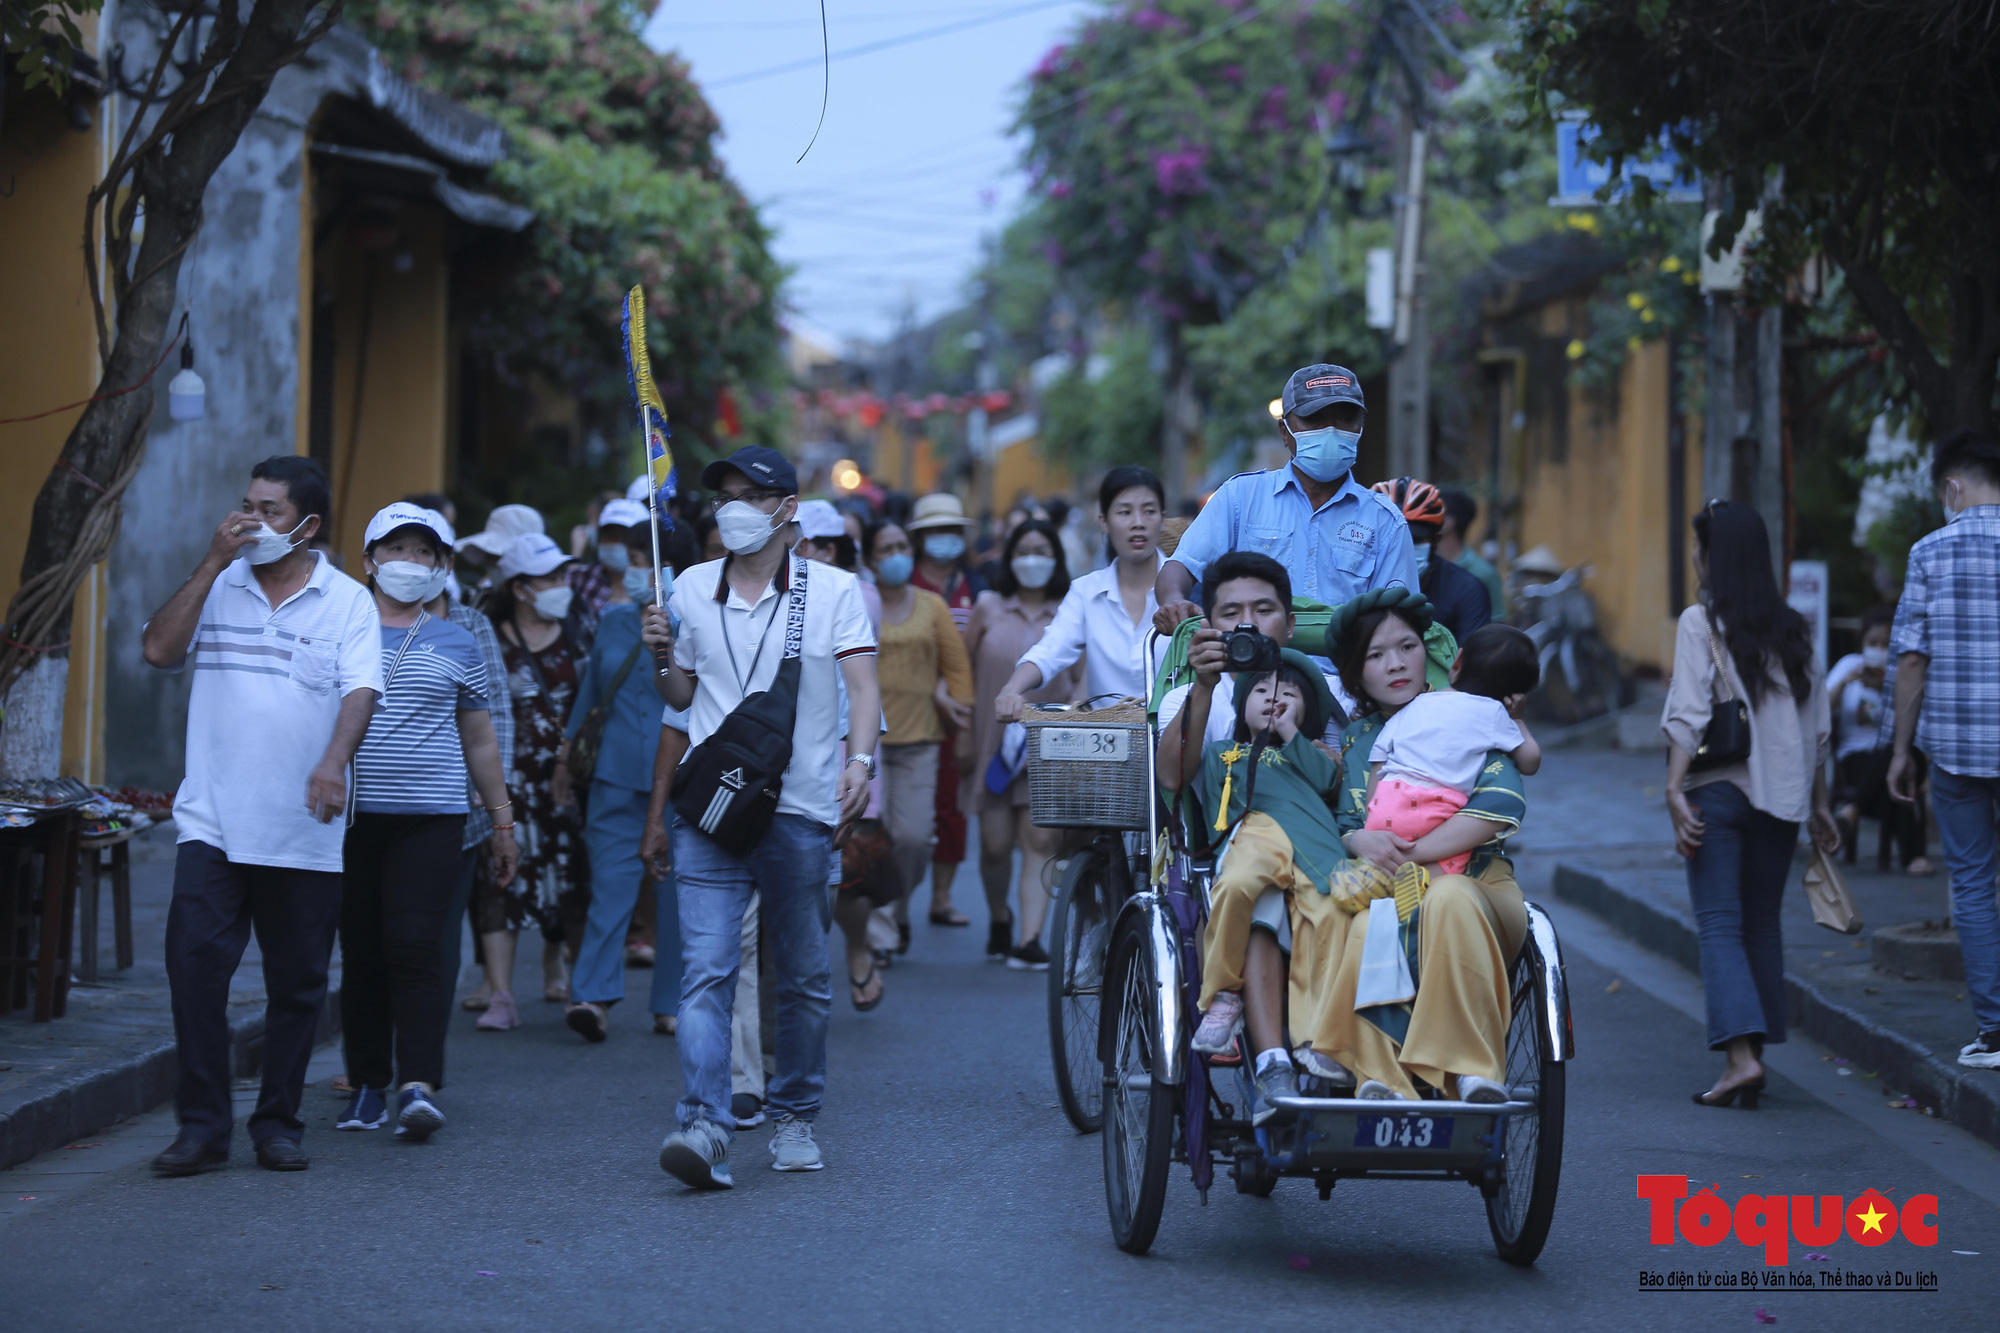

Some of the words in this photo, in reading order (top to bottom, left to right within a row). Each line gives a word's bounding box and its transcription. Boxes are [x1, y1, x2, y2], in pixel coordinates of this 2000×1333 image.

[1350, 529, 1364, 540] 043
[1089, 732, 1116, 755] 38
[1374, 1117, 1434, 1148] 043
